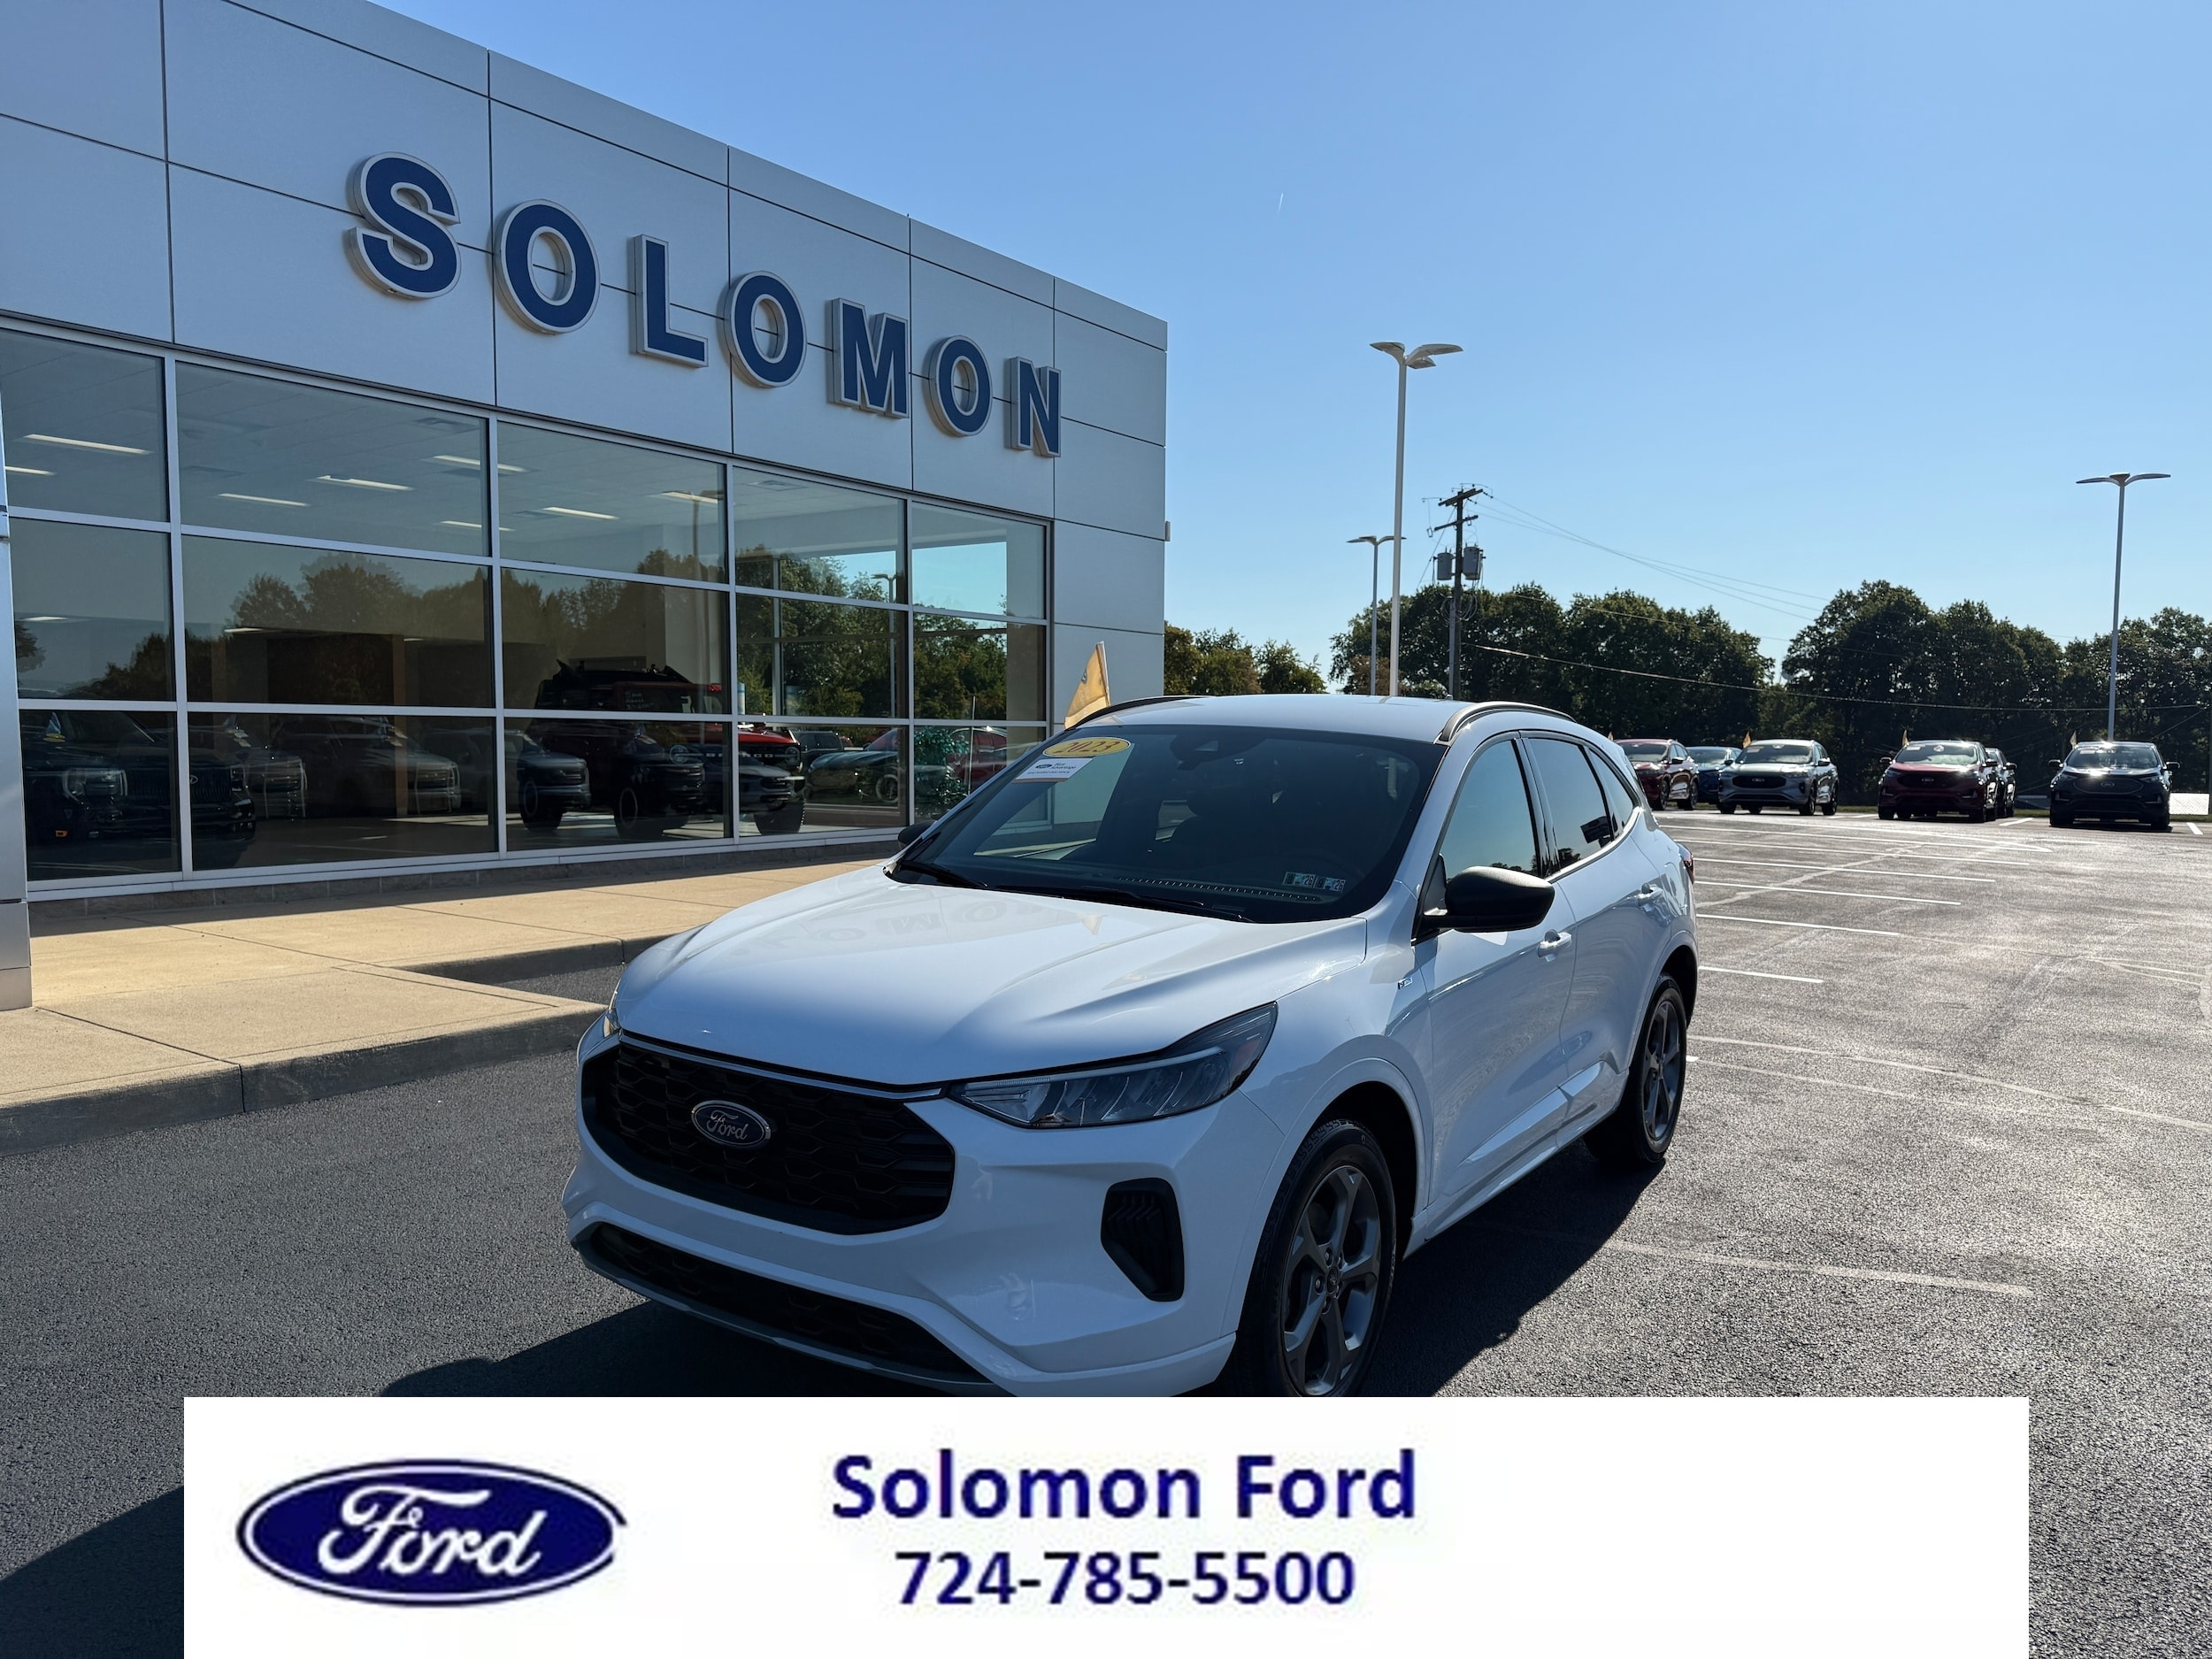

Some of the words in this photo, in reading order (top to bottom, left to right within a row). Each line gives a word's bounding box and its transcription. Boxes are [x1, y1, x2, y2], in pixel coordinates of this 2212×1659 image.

[349, 151, 1061, 458] SOLOMON
[1053, 741, 1120, 753] 2023
[706, 1110, 749, 1141] Ford
